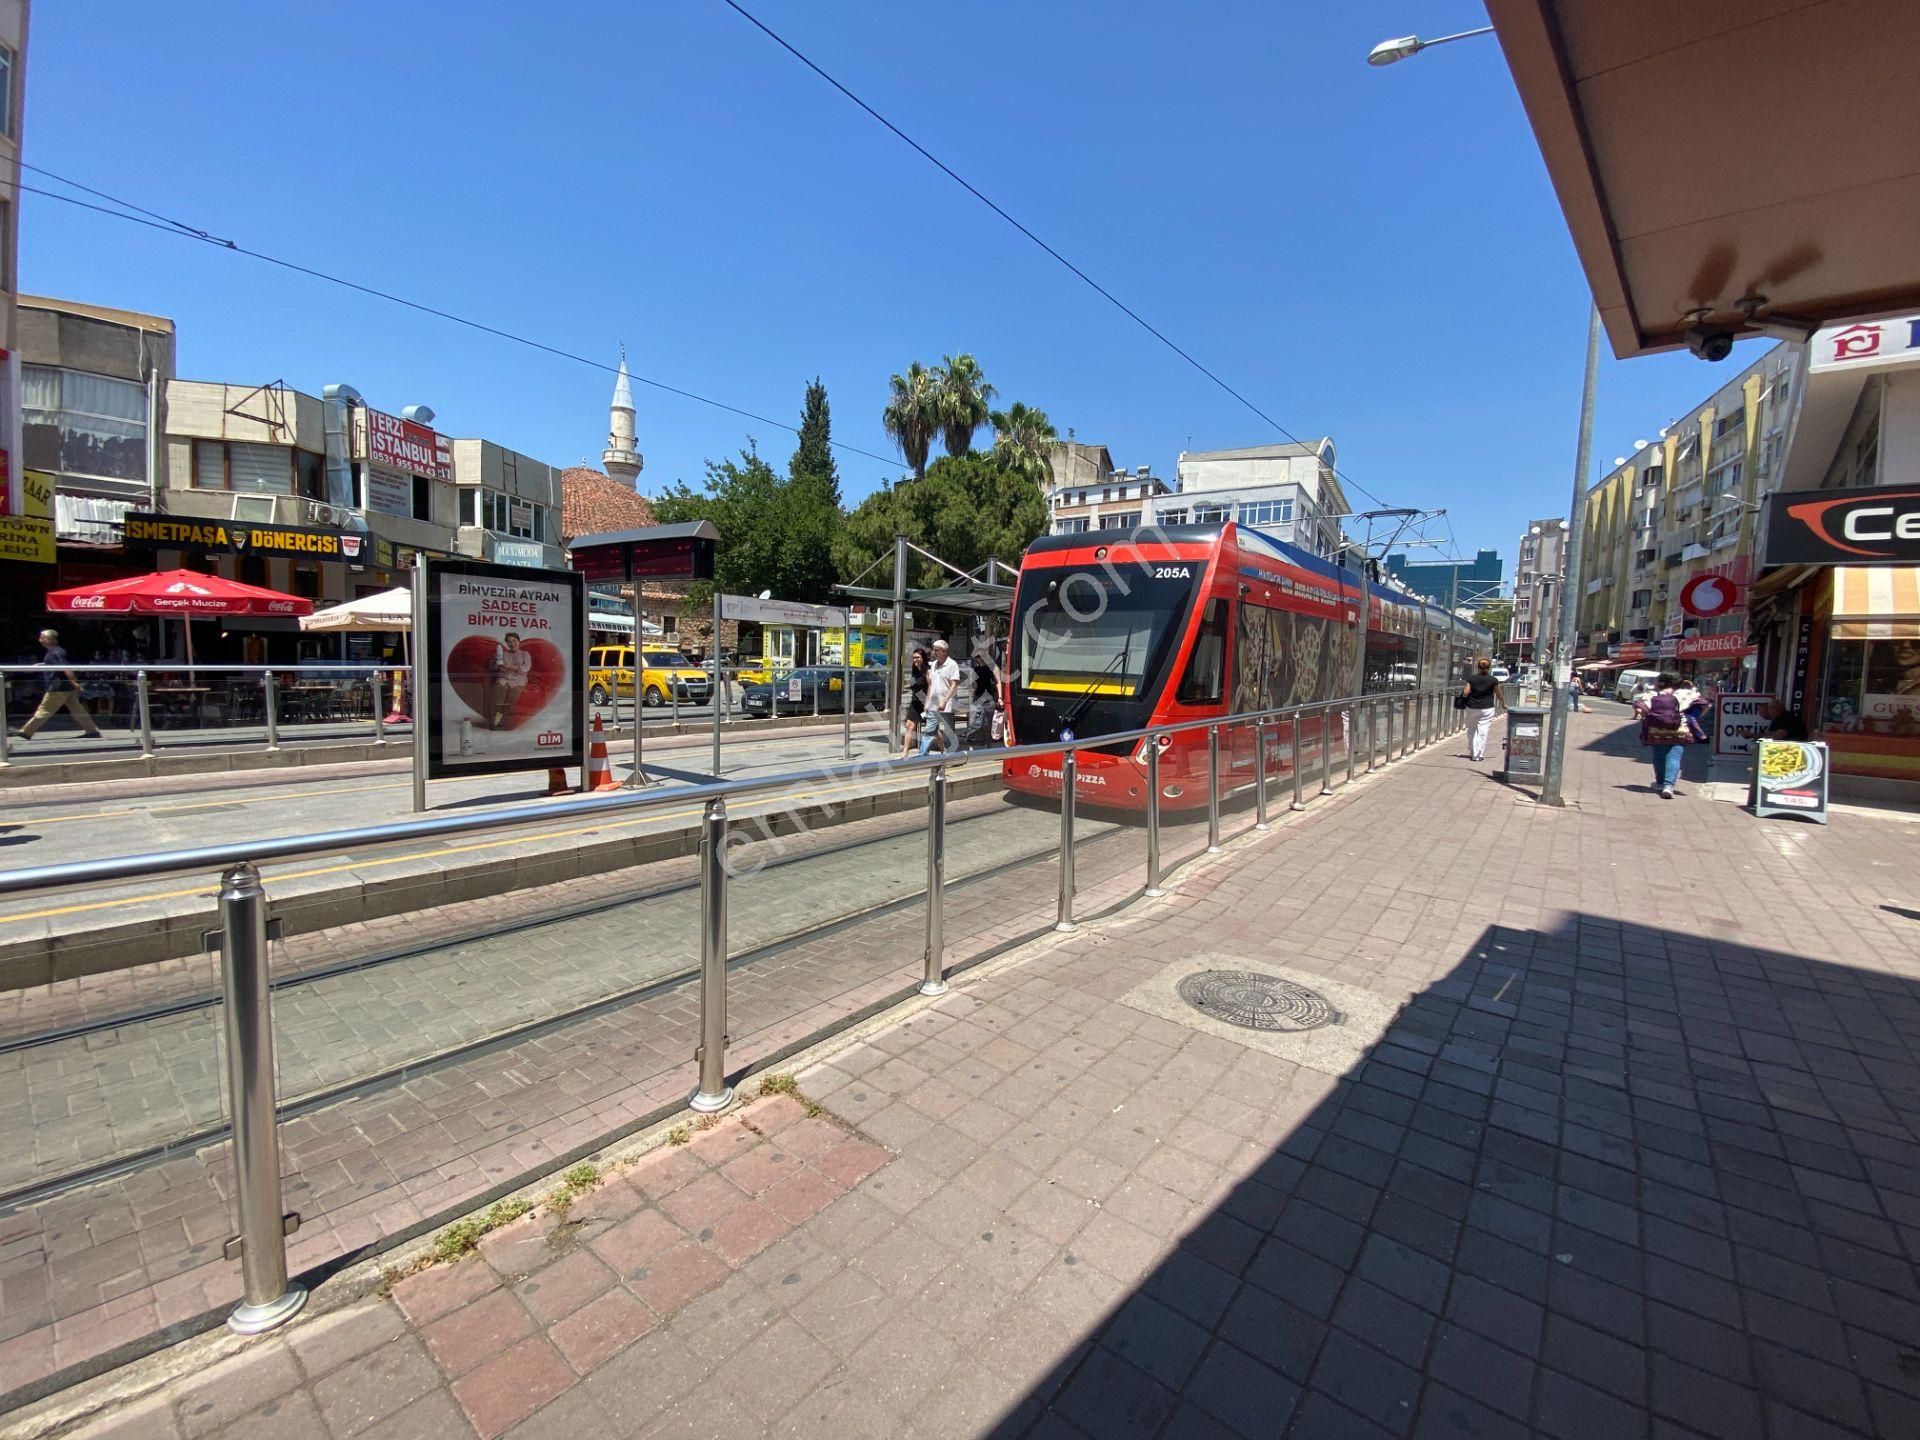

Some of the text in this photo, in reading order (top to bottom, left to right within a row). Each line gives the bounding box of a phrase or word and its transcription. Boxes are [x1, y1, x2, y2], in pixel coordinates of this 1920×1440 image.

[369, 410, 404, 438] TERZİ
[372, 431, 436, 467] İSTANBUL
[372, 451, 394, 465] 0531
[396, 457, 412, 470] 955
[251, 529, 338, 553] DÖNERCİSİ
[1155, 567, 1190, 579] 205A
[459, 582, 559, 602] BİNVEZİR AYRAN
[153, 596, 227, 608] Gerçek Mucize
[481, 599, 536, 613] SADECE
[467, 612, 551, 630] BİM'DE VAR.
[1722, 701, 1769, 715] CEM
